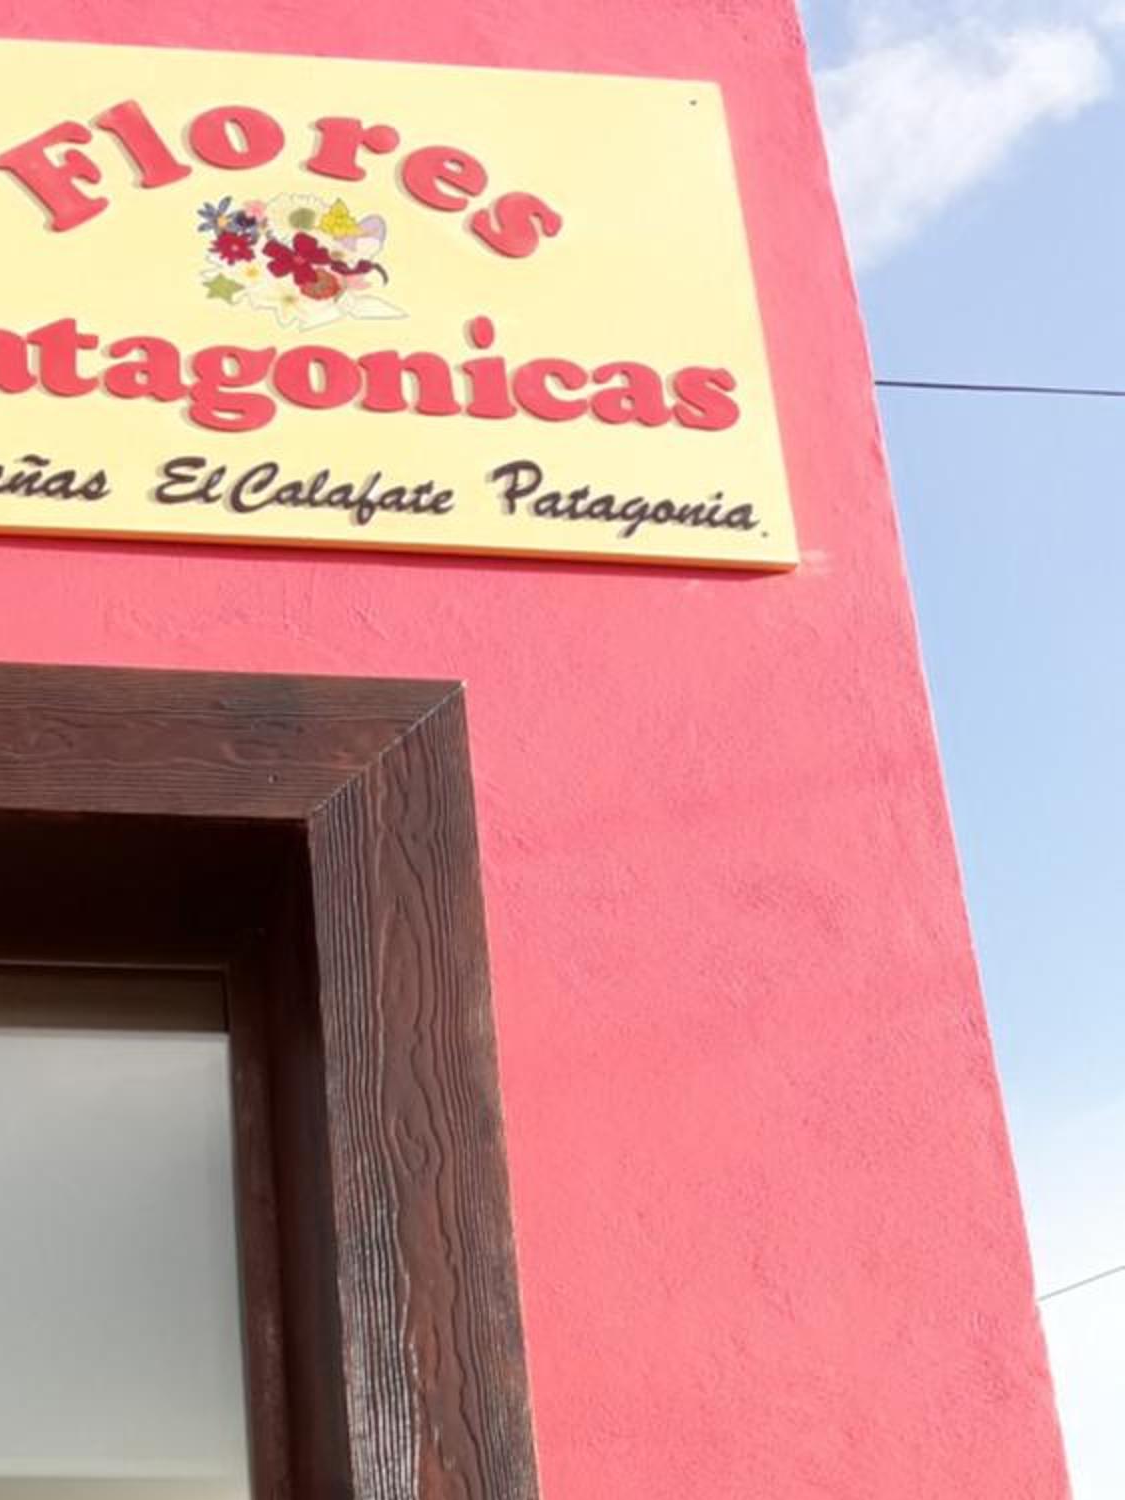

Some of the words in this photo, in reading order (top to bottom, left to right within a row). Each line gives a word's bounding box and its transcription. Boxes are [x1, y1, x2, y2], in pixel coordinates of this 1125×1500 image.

[156, 456, 226, 504] El
[229, 462, 455, 526] Calafate
[491, 459, 759, 538] Patagonia
